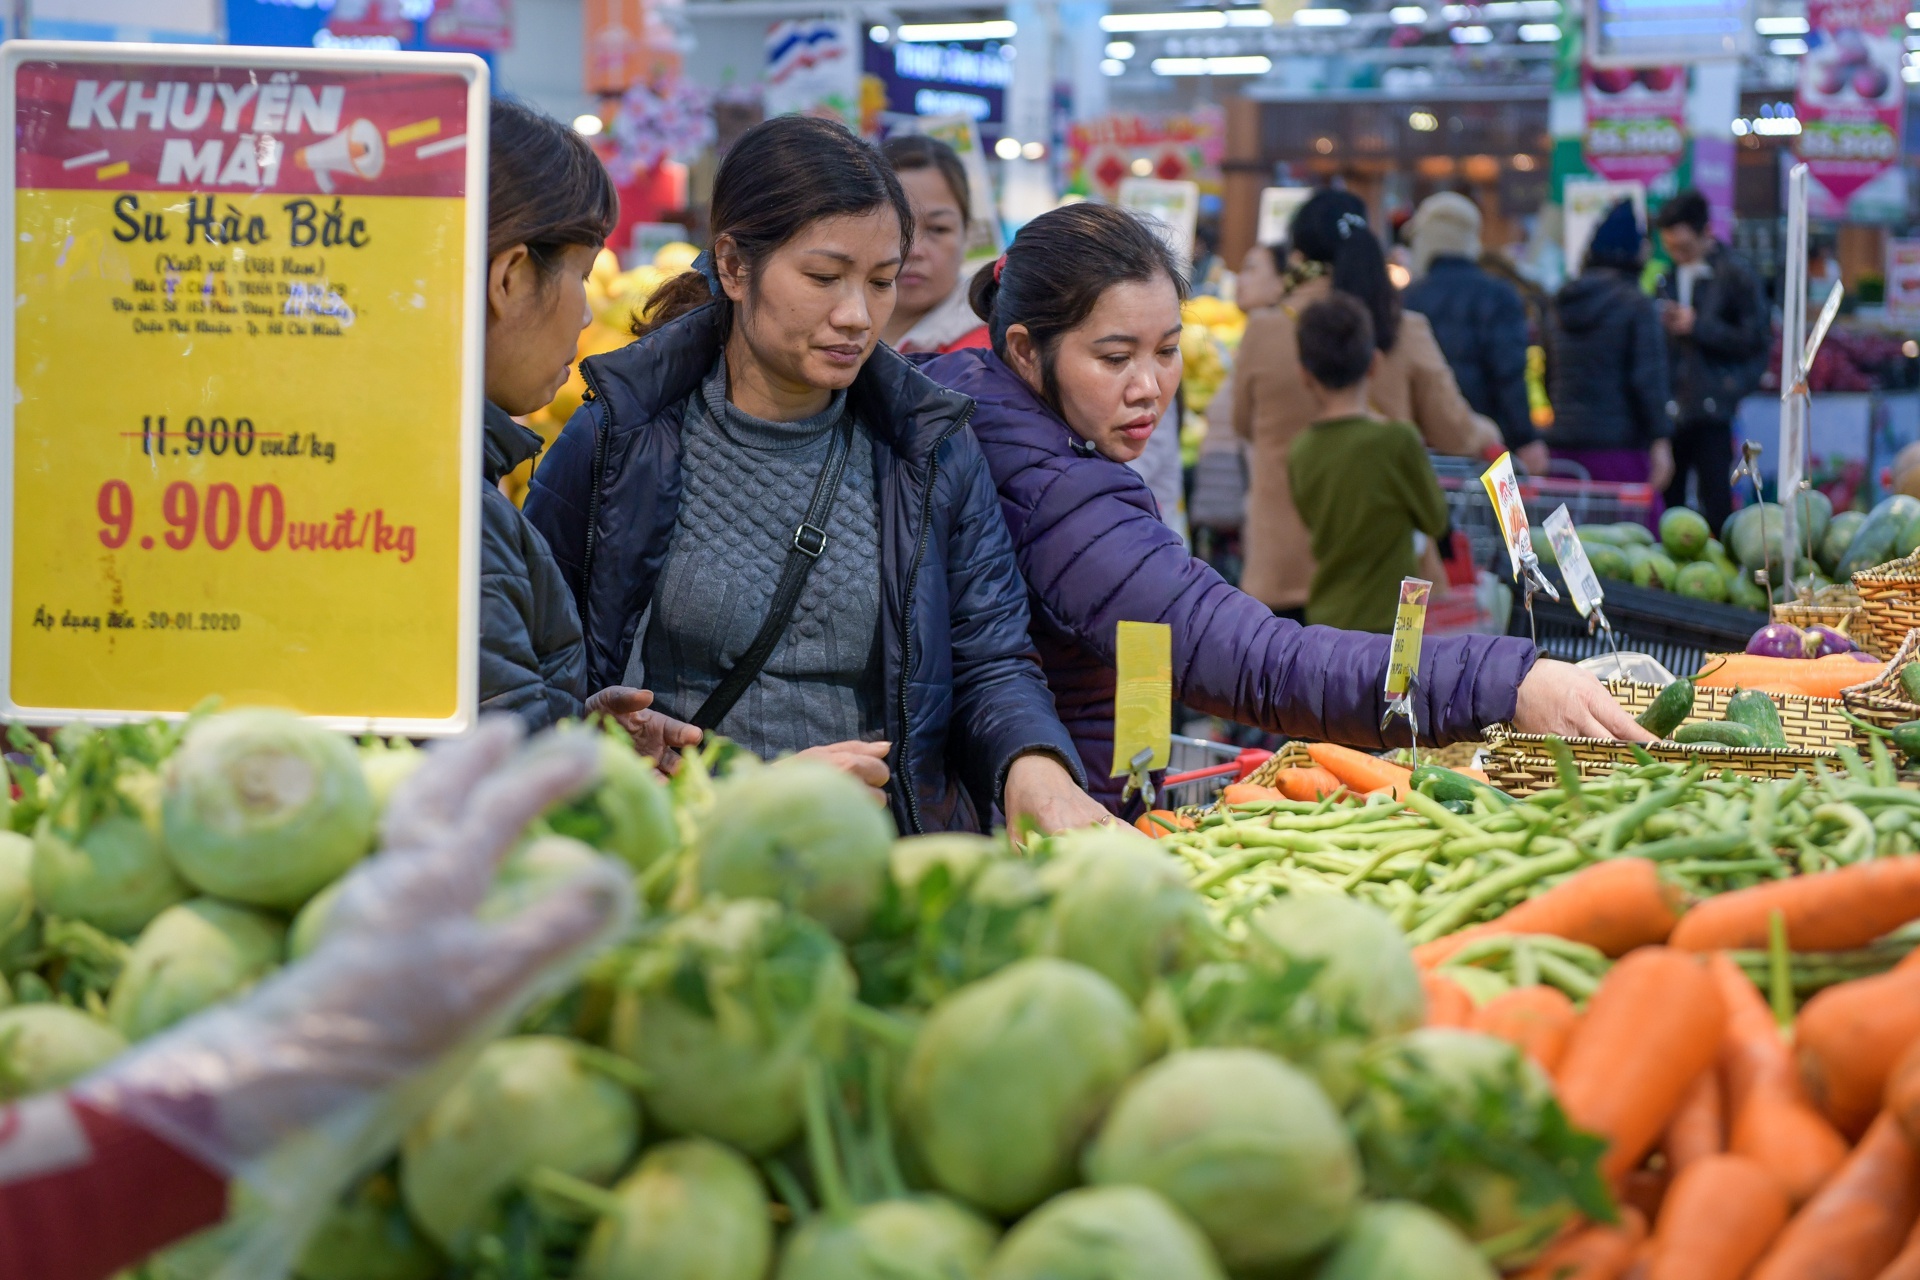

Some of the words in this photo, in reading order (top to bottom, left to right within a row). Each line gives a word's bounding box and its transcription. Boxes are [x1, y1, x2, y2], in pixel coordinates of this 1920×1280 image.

[113, 193, 171, 243] Su
[186, 194, 270, 245] Hào
[283, 197, 370, 249] Bắc
